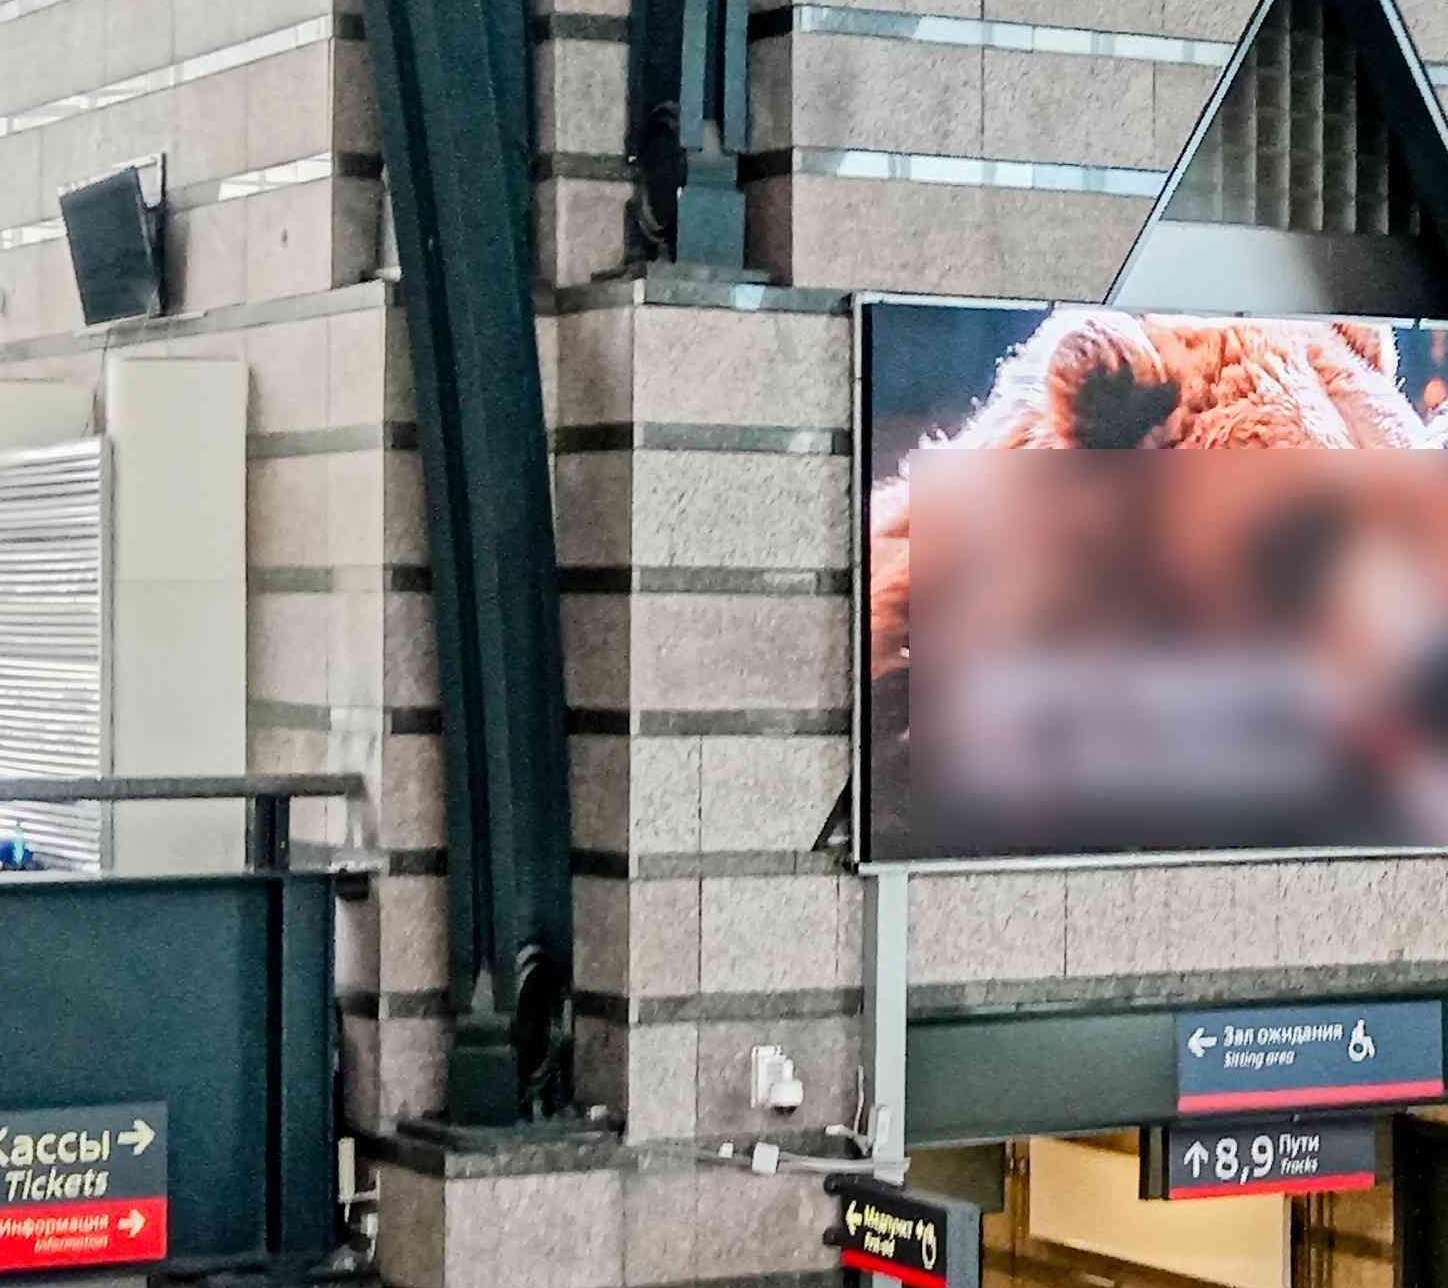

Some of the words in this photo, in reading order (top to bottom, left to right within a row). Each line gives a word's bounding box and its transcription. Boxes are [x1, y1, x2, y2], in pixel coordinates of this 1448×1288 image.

[1223, 1025, 1254, 1047] Зал
[1257, 1023, 1344, 1046] ожидания
[1215, 1135, 1274, 1186] 8,9
[1278, 1133, 1320, 1157] Пути
[5, 1167, 109, 1201] Tickets
